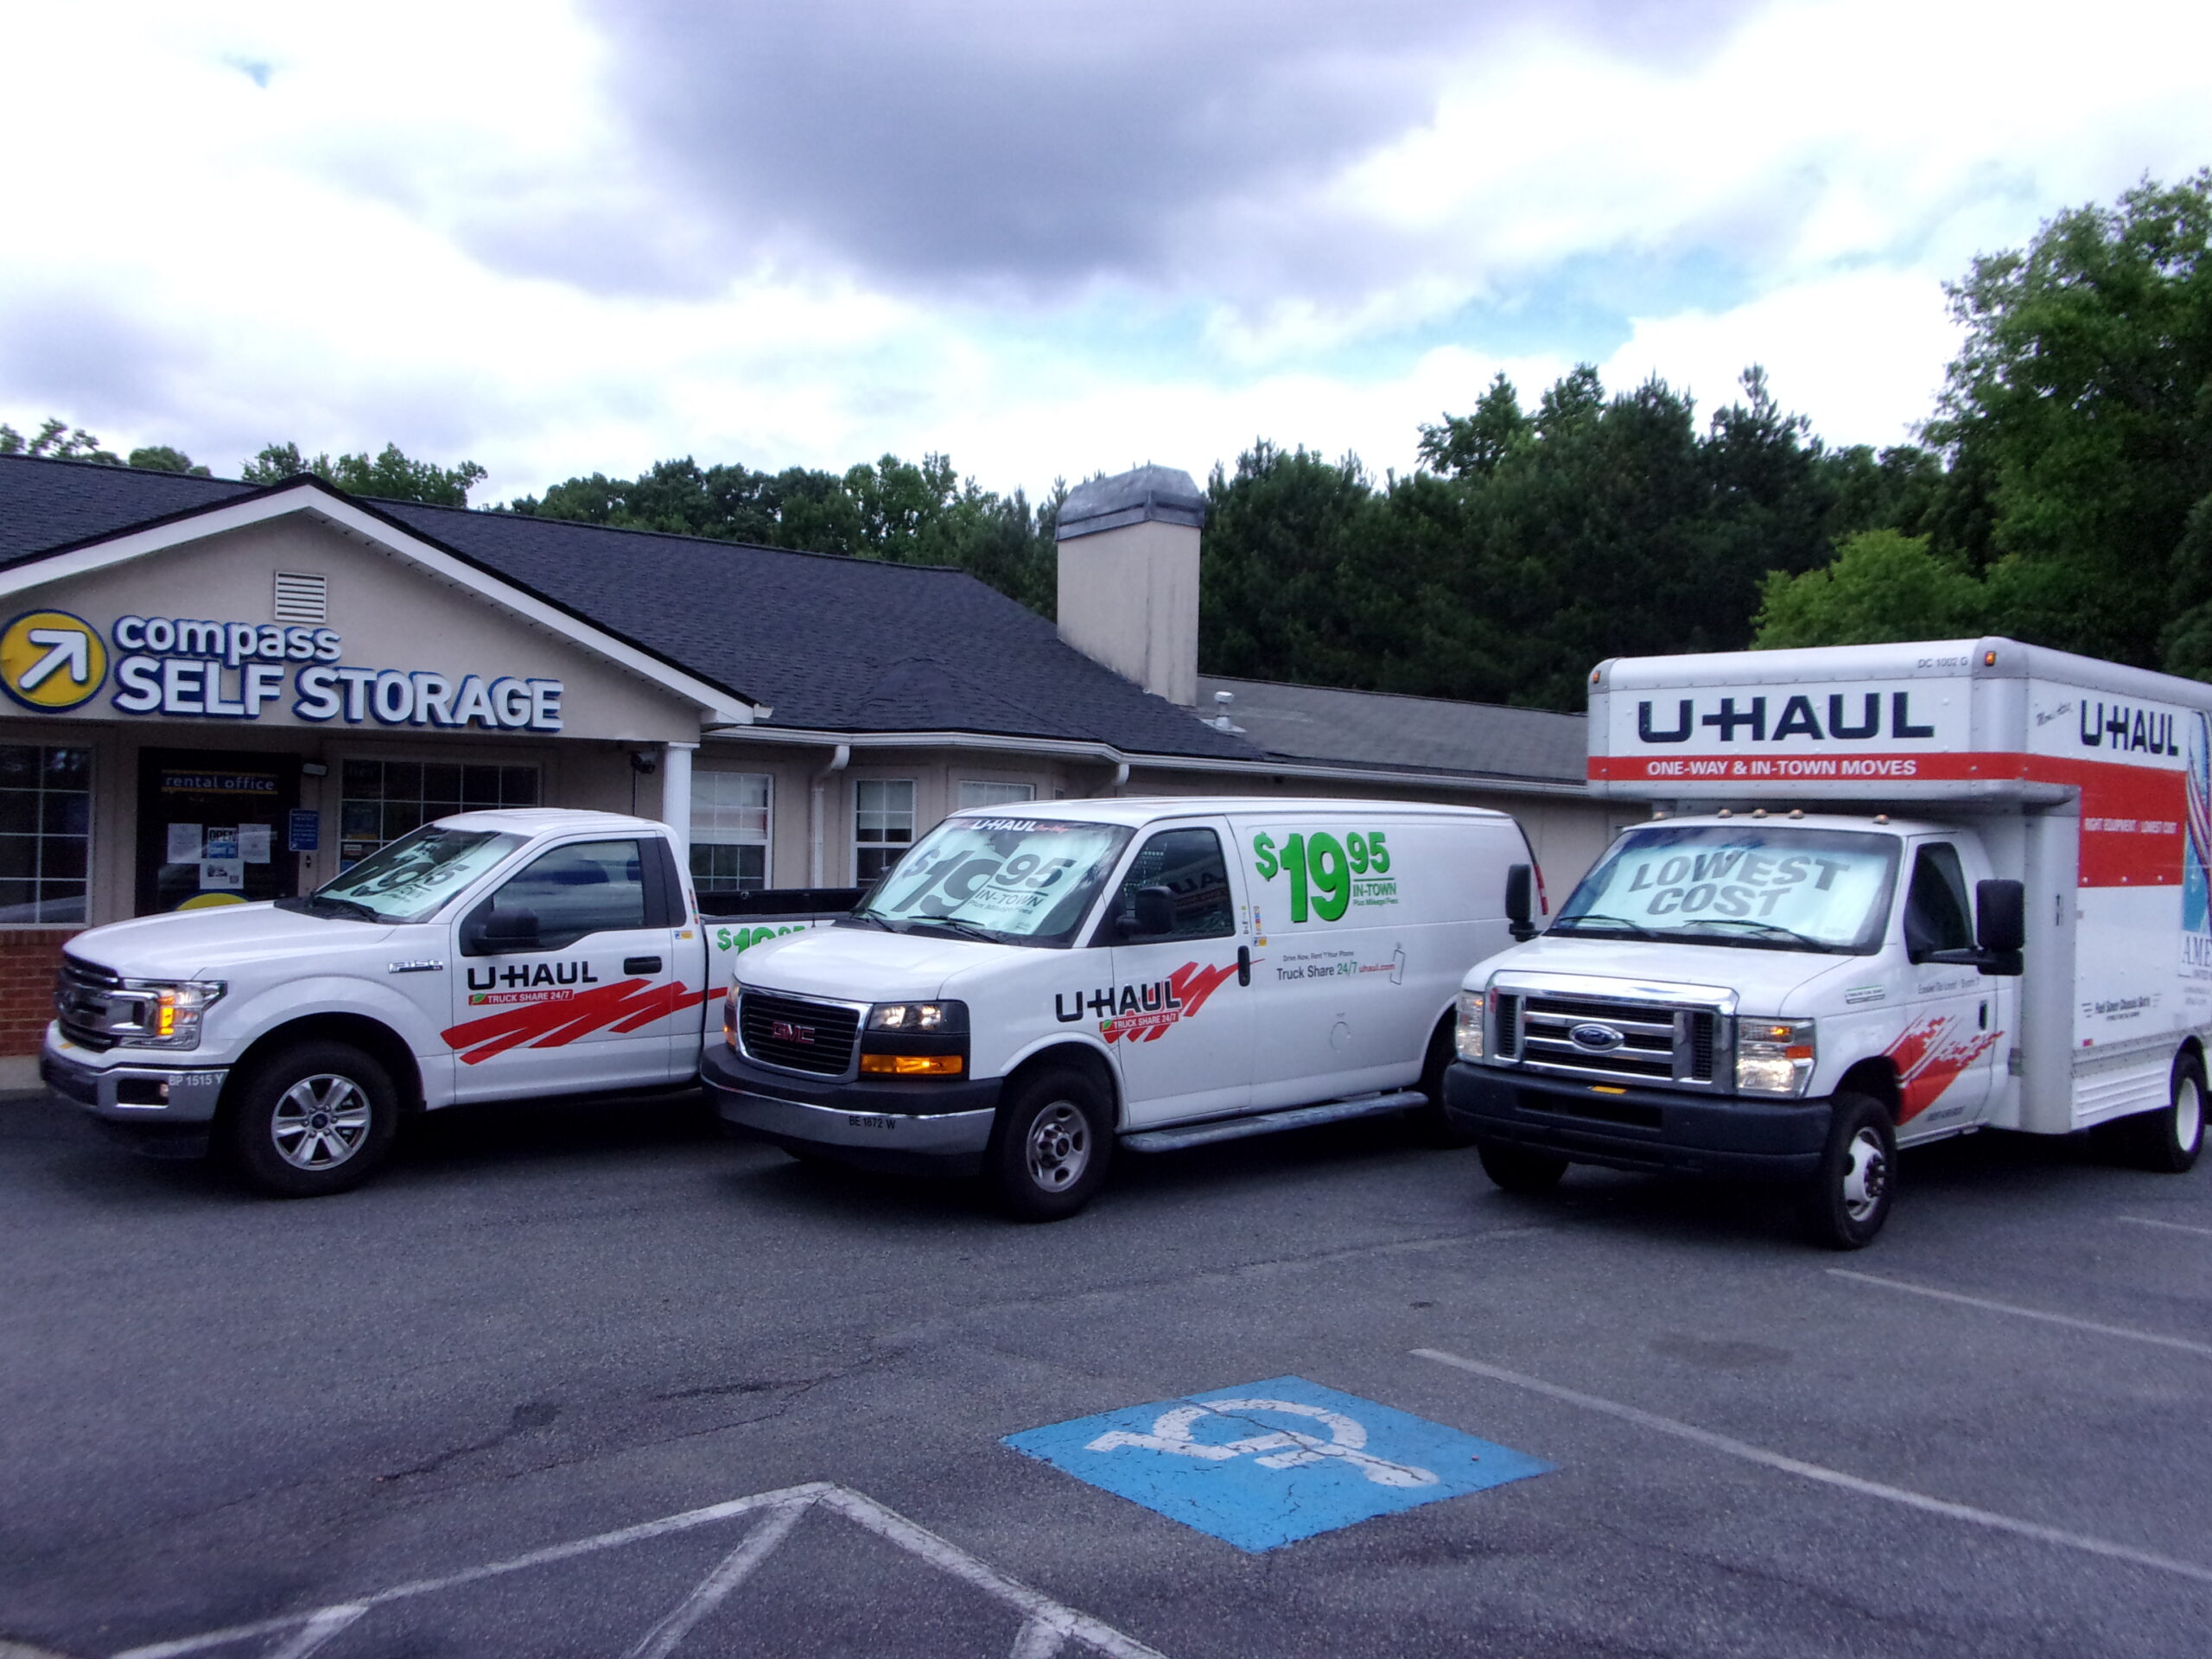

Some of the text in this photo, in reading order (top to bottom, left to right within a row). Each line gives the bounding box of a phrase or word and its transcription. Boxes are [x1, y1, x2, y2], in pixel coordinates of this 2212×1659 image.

[113, 615, 342, 668] compass
[111, 655, 564, 733] SELF STORAGE
[1637, 691, 1935, 743] U-HAUL
[1647, 760, 1916, 776] ONE-WAY & IN-TOWN MOVES
[165, 777, 275, 790] rental office
[210, 830, 239, 842] OPEN
[1628, 850, 1851, 893] LOWEST
[976, 889, 1044, 907] IN-TOWN
[1353, 882, 1396, 897] IN-TOWN
[1646, 883, 1793, 917] COST
[467, 961, 598, 990] U-HAUL
[1277, 966, 1305, 981] Truck
[1307, 964, 1334, 978] Share
[1337, 960, 1358, 976] 24/7
[487, 991, 569, 1004] TRUCK SHARE 24/7
[1056, 981, 1182, 1022] U-HAUL
[1114, 1014, 1177, 1029] TRUCK SHARE 24/7
[772, 1021, 815, 1044] GMC
[168, 1073, 223, 1086] BP 1515 Y
[849, 1116, 861, 1127] BE
[886, 1119, 896, 1129] W
